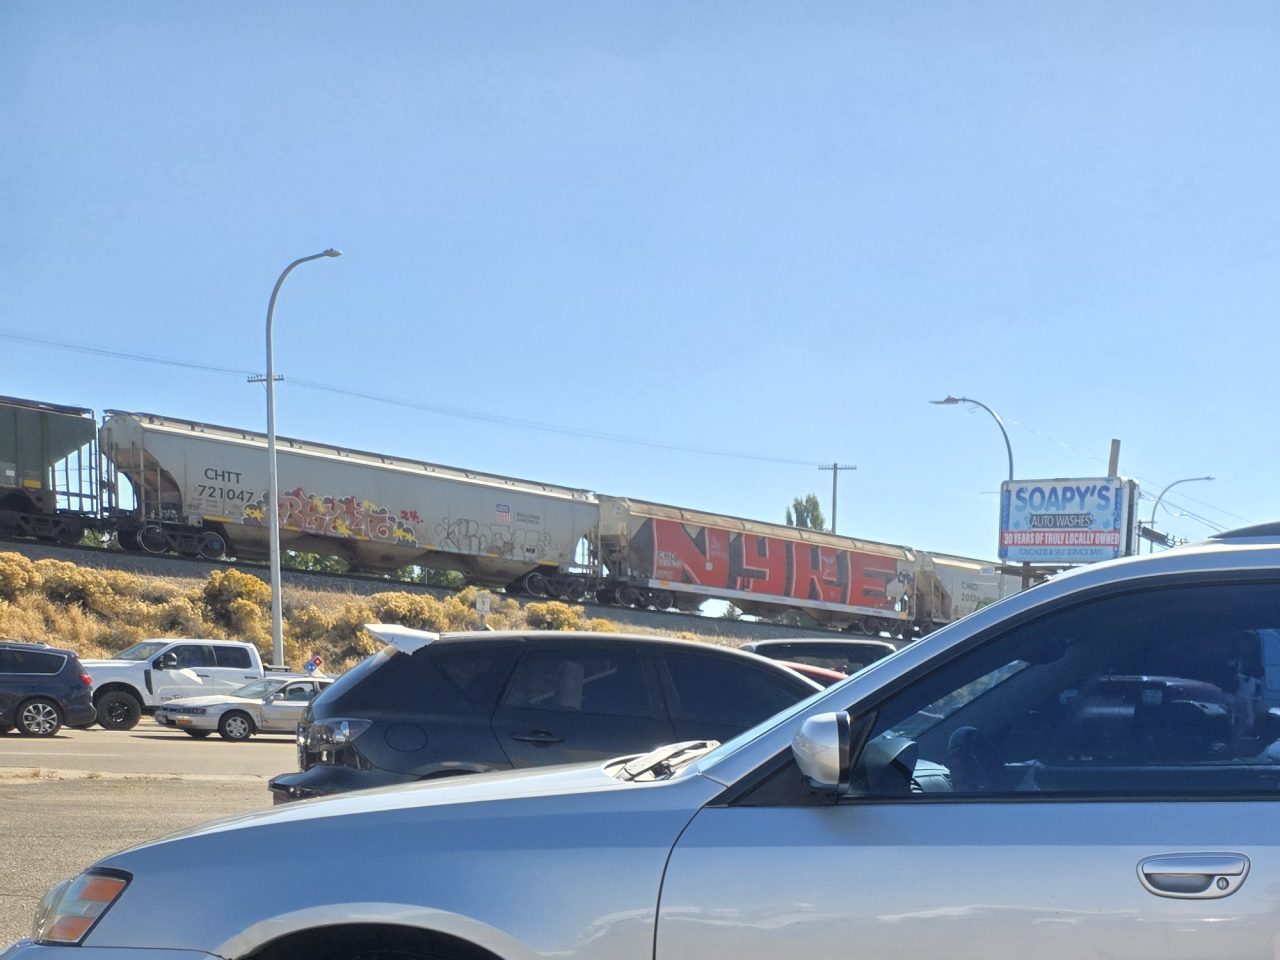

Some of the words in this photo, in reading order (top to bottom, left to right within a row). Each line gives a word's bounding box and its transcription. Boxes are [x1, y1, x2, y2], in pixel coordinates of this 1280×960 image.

[204, 467, 242, 484] CHTT
[198, 484, 255, 503] 721047
[1015, 485, 1111, 512] SOAPY'S
[1031, 515, 1054, 527] AUTO
[1055, 514, 1091, 527] WASHES
[1004, 533, 1013, 545] 30
[1014, 533, 1035, 545] YEARS
[1035, 533, 1045, 544] OF
[1045, 532, 1065, 545] TRULY
[1065, 532, 1095, 545] LOCALLY
[1095, 532, 1120, 545] OWNED
